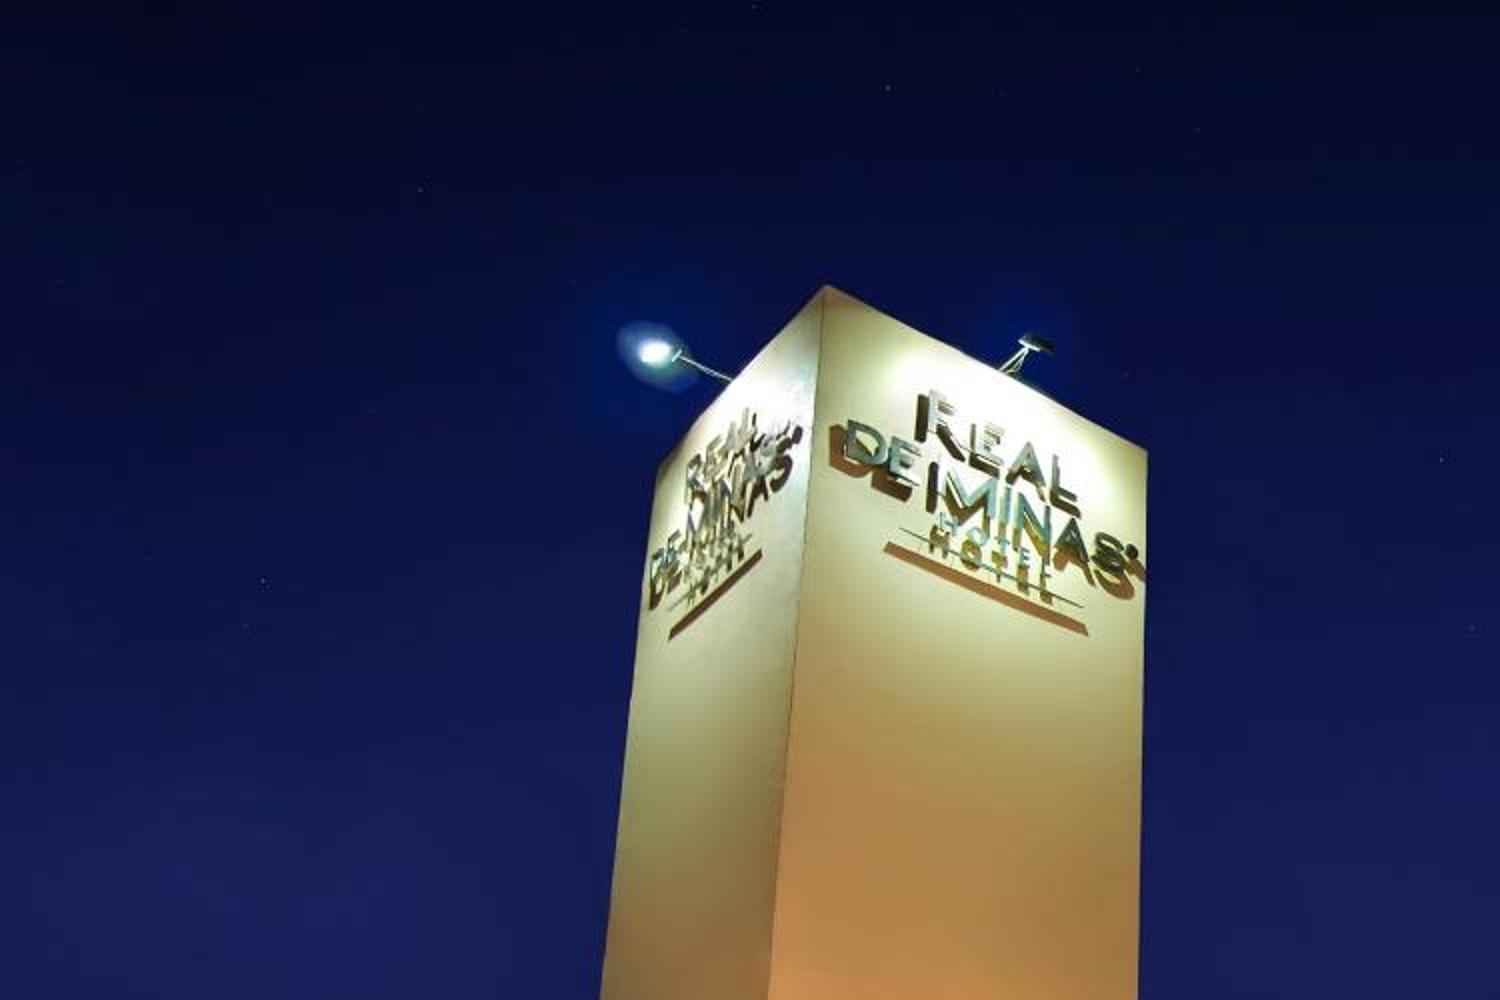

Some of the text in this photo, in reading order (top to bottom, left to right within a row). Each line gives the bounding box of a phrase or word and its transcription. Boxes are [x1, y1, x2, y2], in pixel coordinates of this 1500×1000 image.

[834, 419, 921, 497] DE
[916, 389, 1081, 517] REAL
[931, 512, 1054, 598] HOTEL
